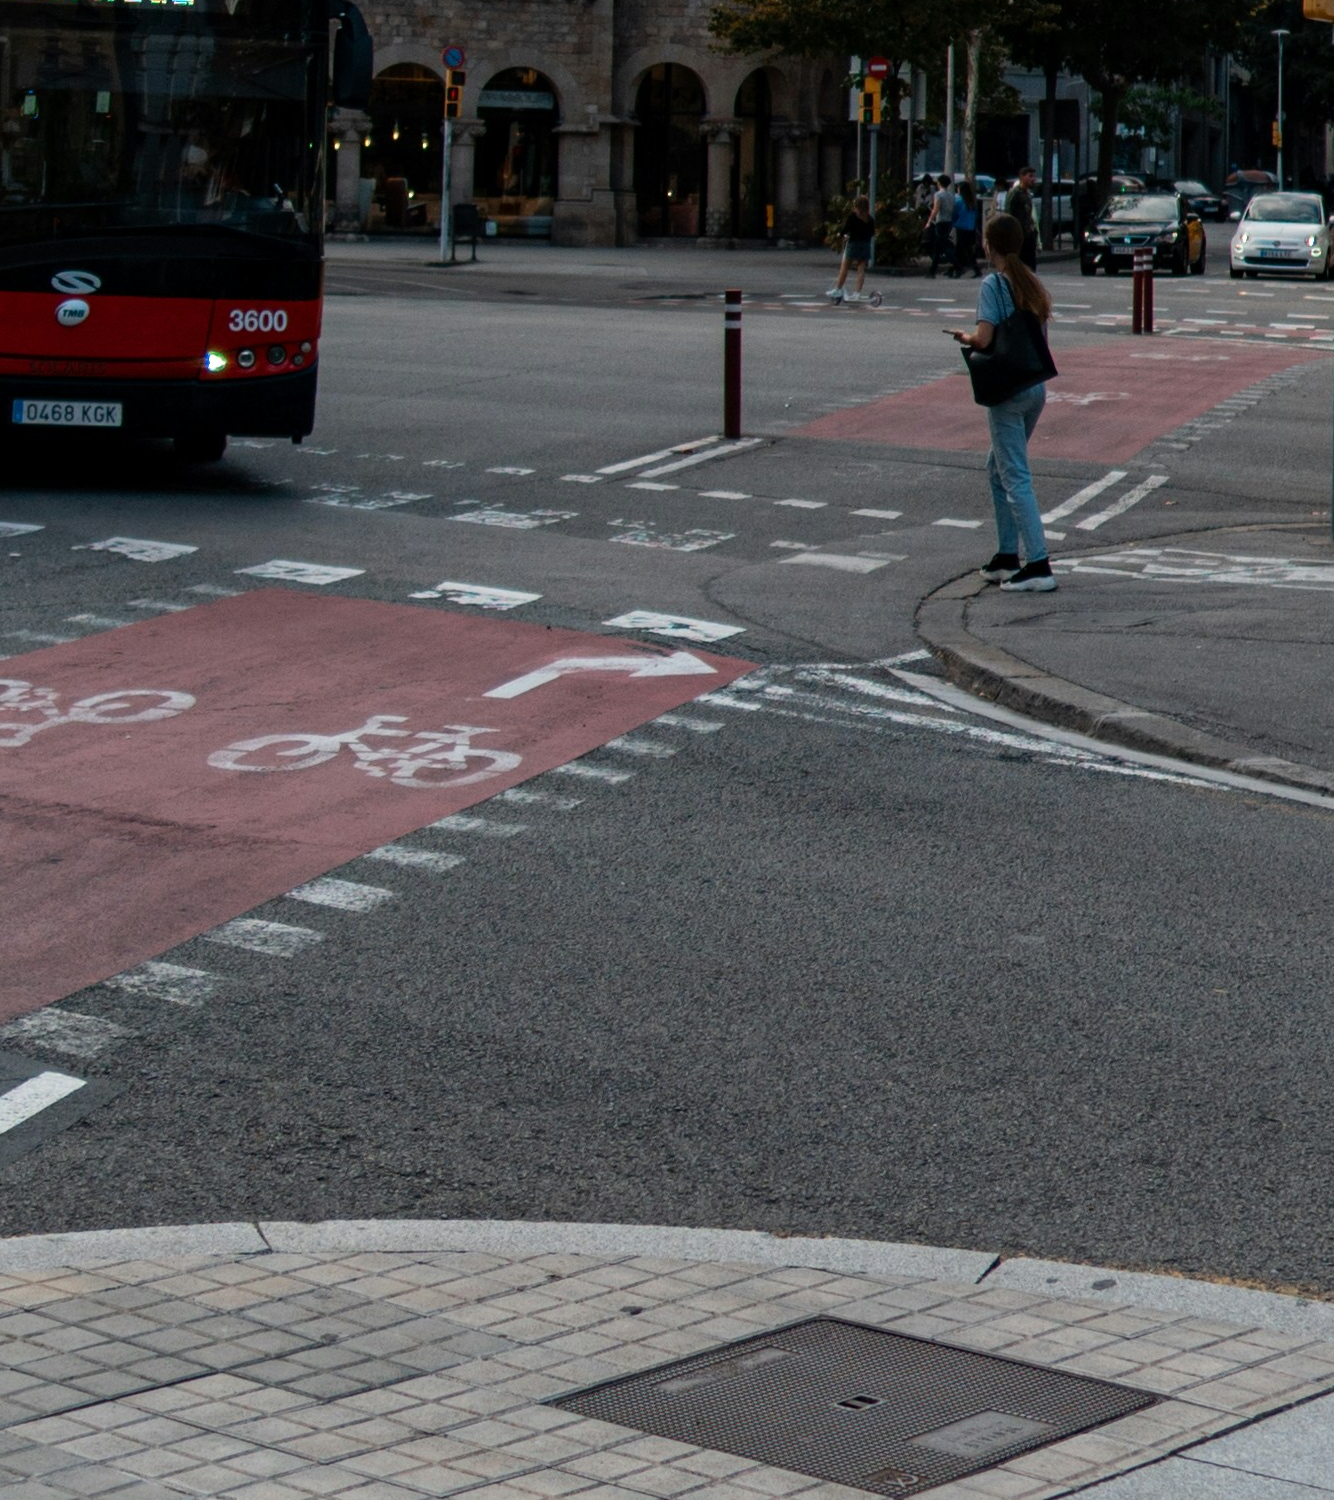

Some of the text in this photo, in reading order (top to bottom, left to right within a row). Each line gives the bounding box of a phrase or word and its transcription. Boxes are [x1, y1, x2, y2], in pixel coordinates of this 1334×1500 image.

[63, 309, 86, 318] TMB
[228, 309, 288, 333] 3600
[27, 403, 117, 424] 0468 KGK
